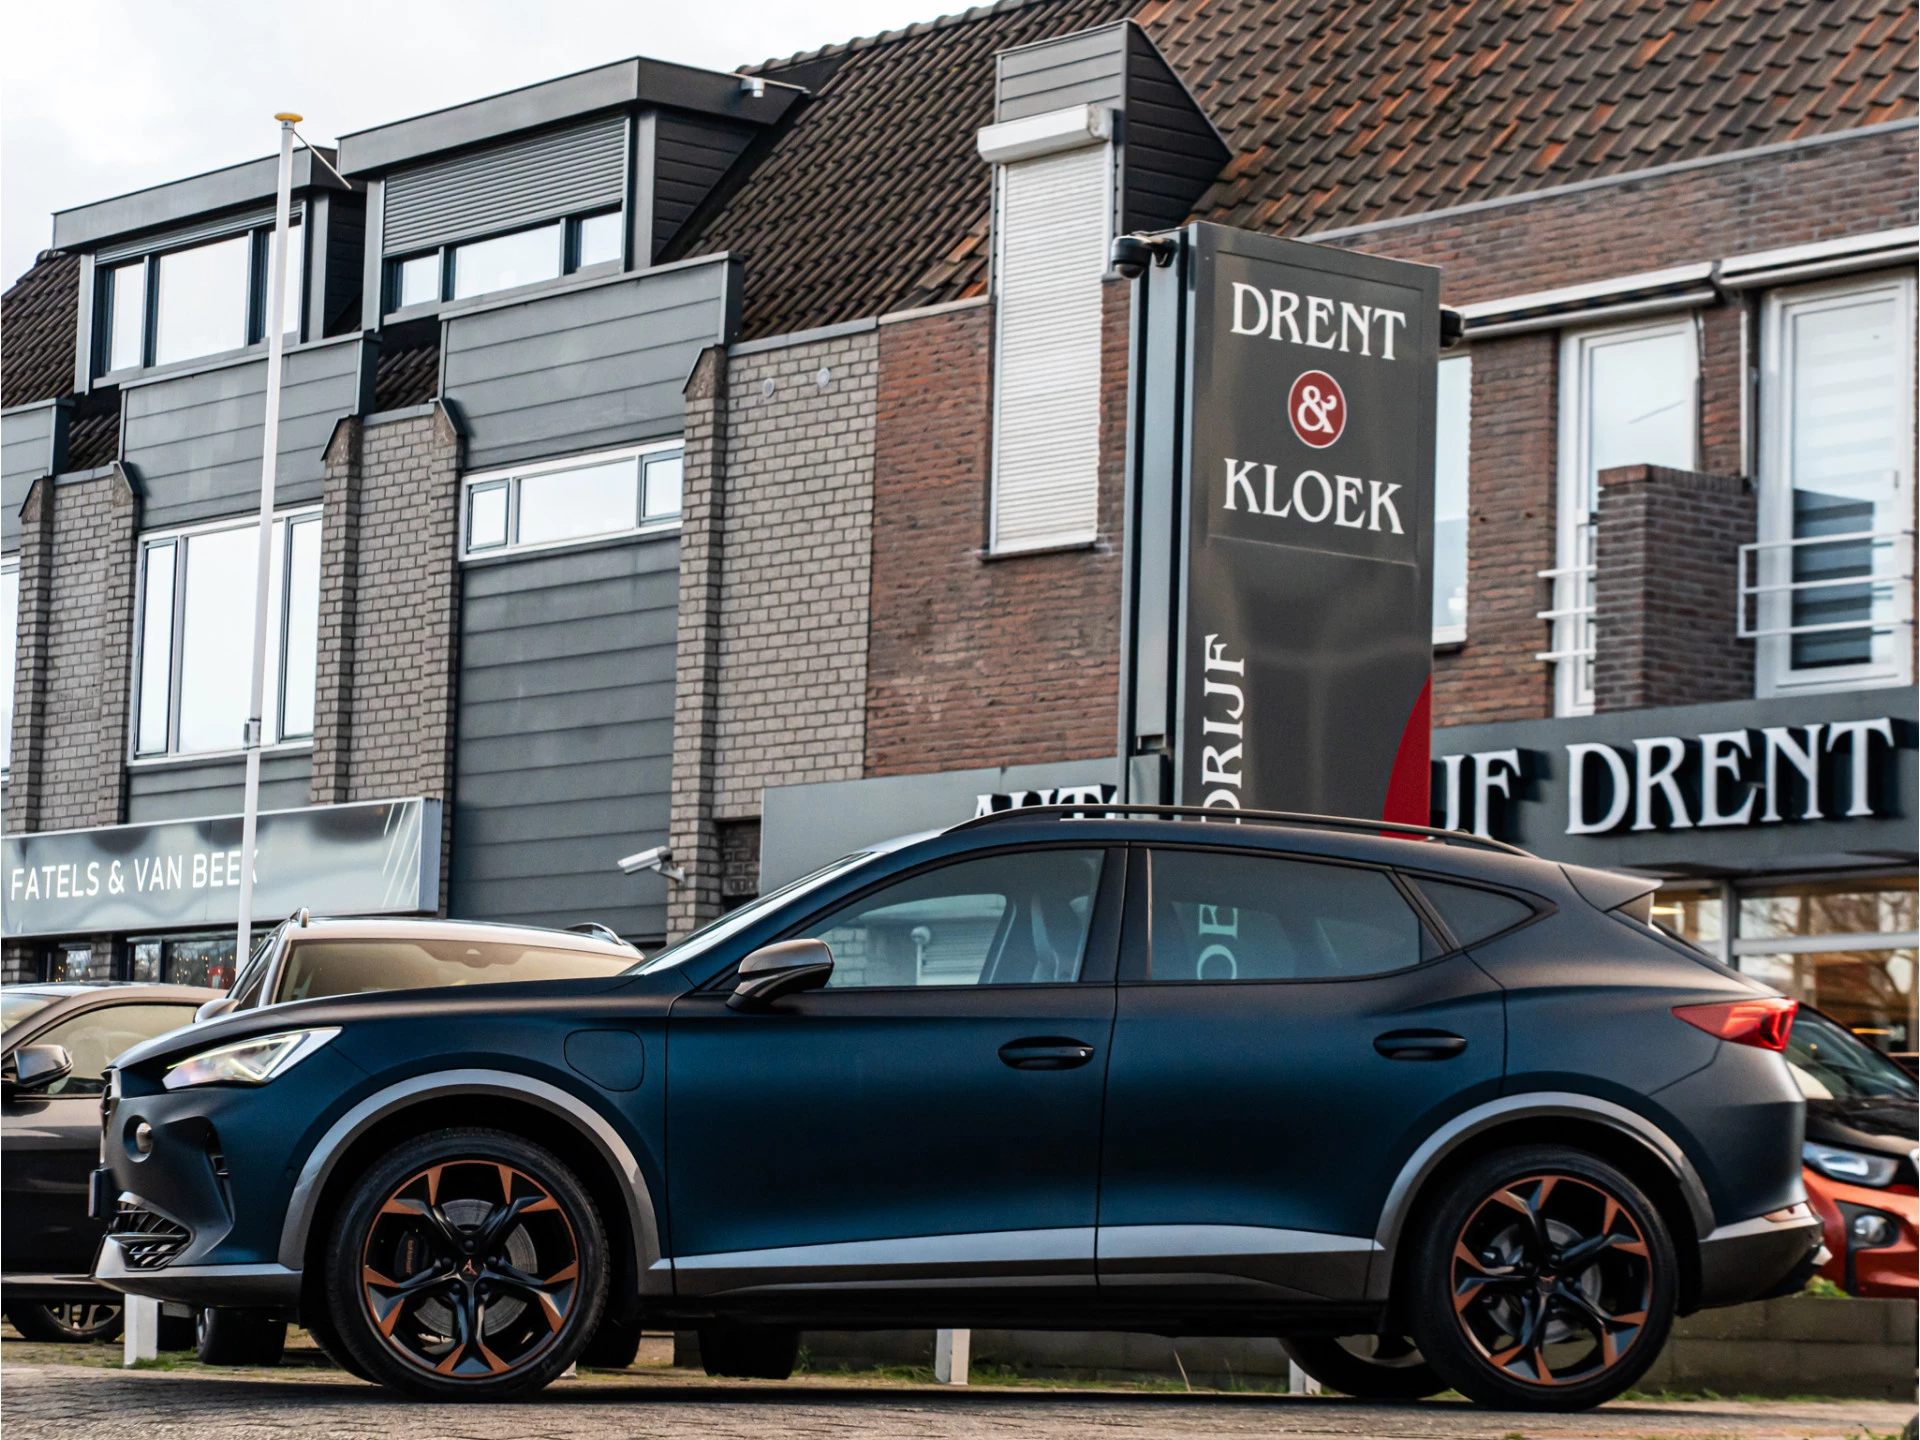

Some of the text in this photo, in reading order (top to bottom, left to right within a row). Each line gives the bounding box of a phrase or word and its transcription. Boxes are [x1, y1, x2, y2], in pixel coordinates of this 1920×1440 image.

[1231, 282, 1407, 360] DRENT
[1297, 385, 1337, 434] &
[1223, 457, 1405, 534] KLOEK
[1565, 717, 1894, 835] DRENT
[11, 861, 100, 901] FATELS
[108, 860, 125, 895] &
[134, 854, 183, 892] VAN
